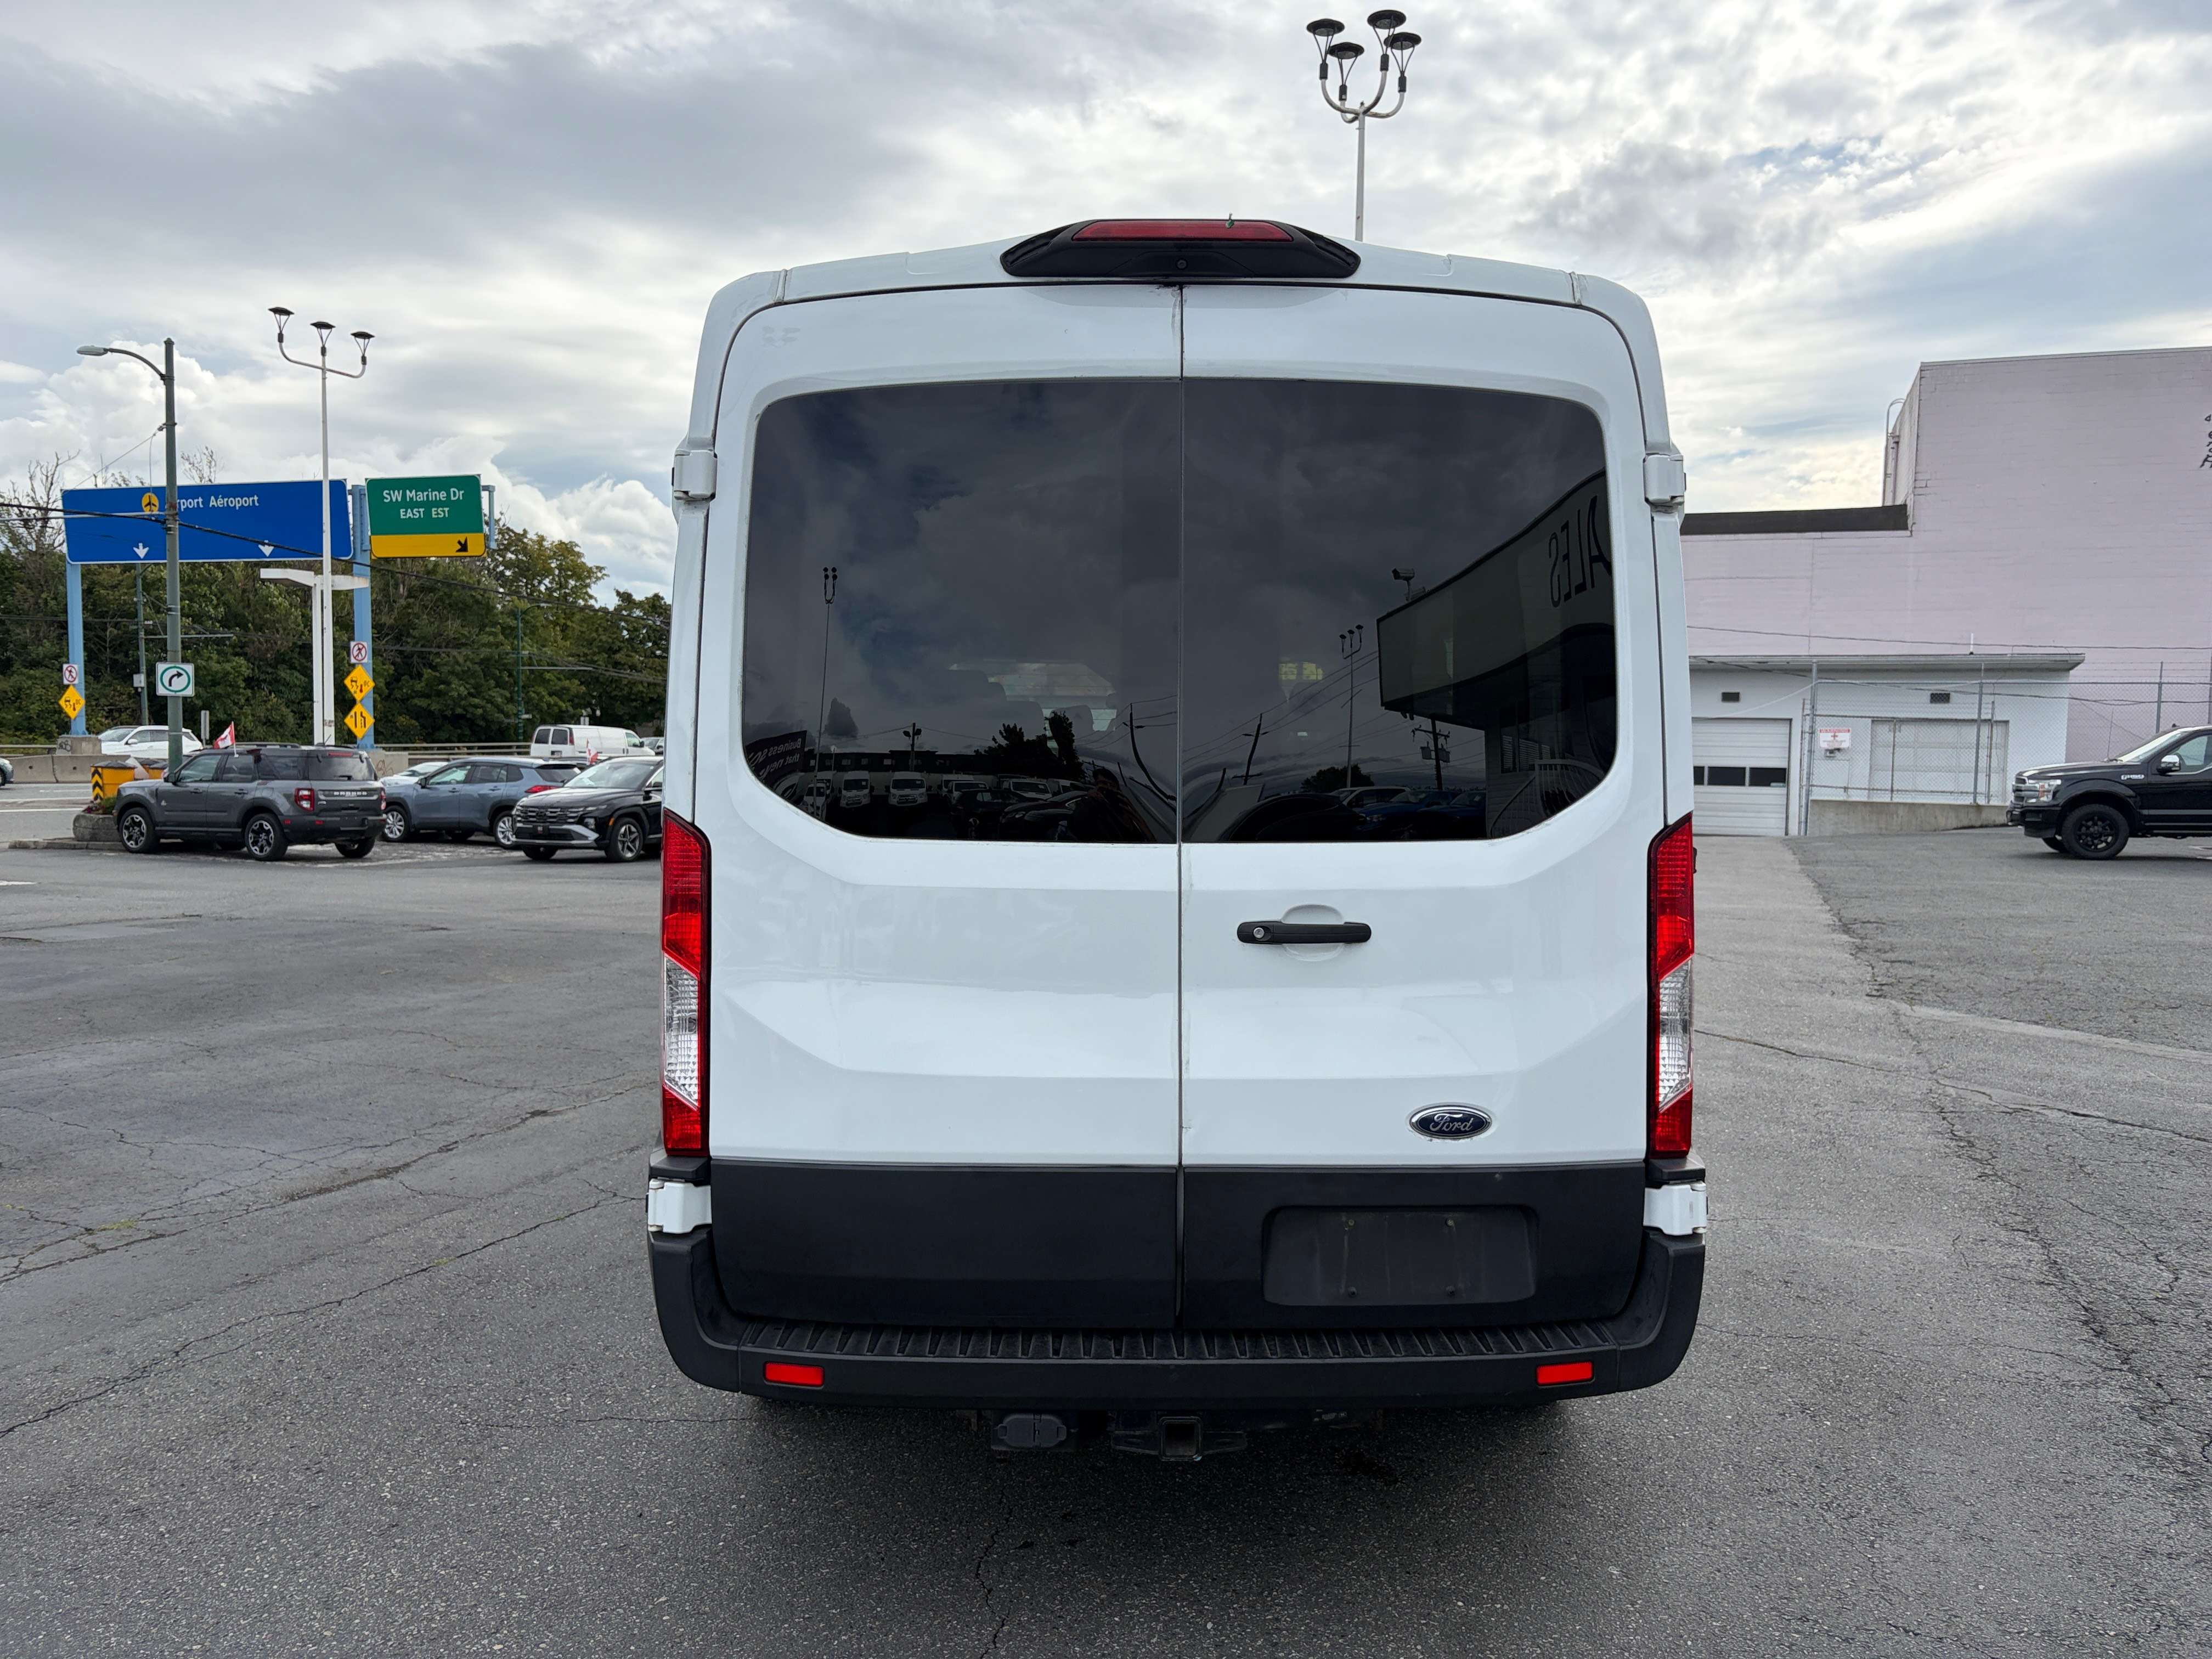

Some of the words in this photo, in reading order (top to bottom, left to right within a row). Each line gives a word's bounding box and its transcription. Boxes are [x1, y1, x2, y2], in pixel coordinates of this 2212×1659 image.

[177, 496, 204, 512] rport
[209, 494, 259, 510] Aéroport
[383, 489, 403, 503] SW
[406, 488, 447, 502] Marine
[450, 487, 465, 500] Dr
[400, 508, 425, 519] EAST
[432, 507, 449, 518] EST
[1429, 1113, 1474, 1131] Ford
